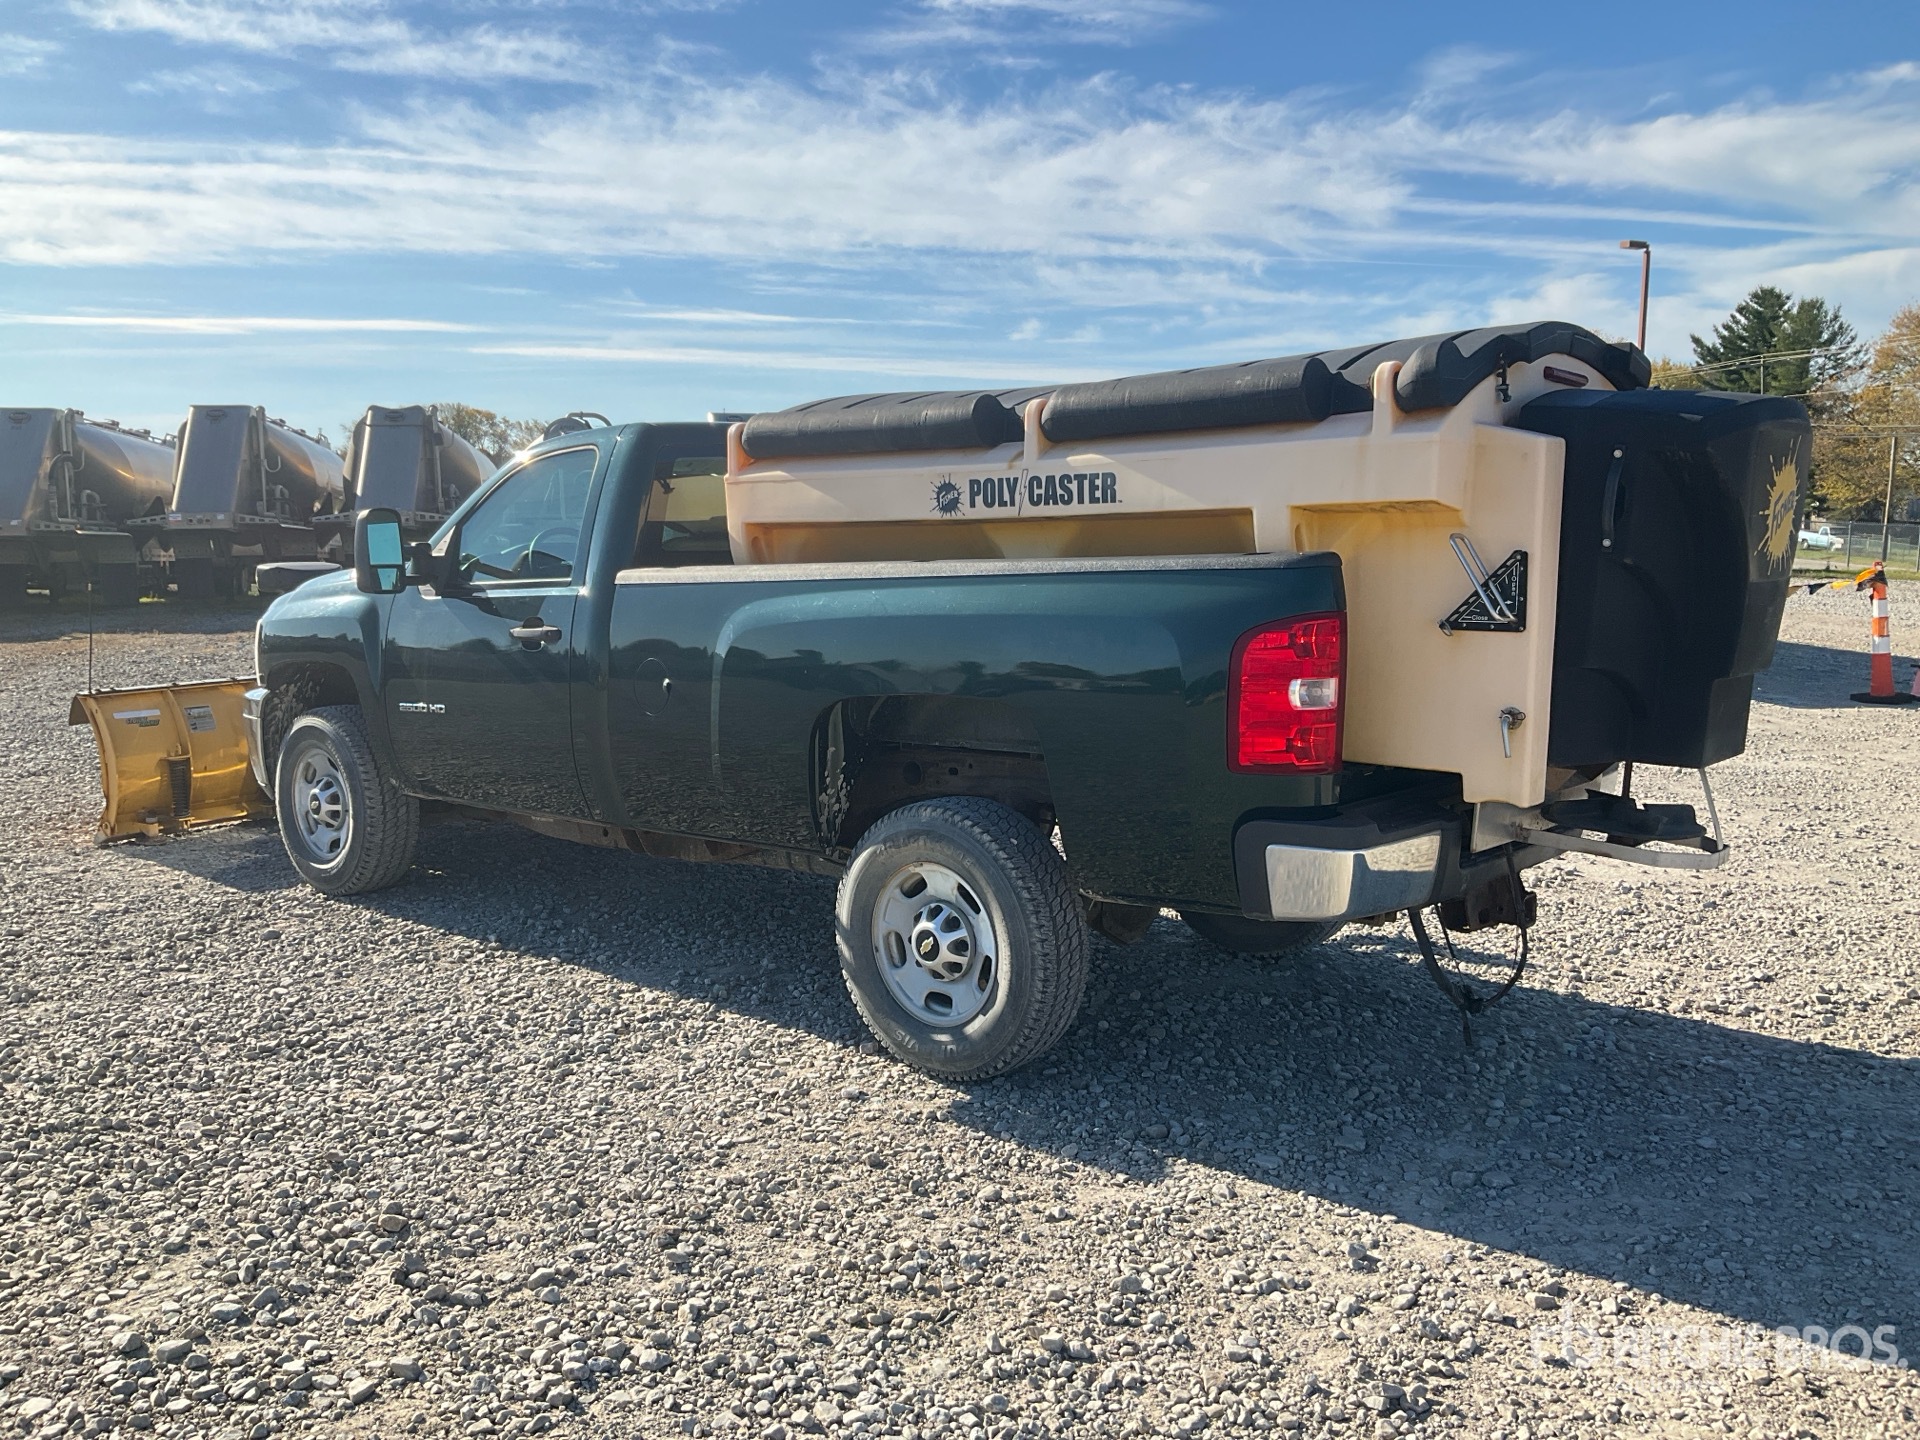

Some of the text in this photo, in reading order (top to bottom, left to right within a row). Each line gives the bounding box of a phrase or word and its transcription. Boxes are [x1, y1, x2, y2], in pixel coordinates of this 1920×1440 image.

[969, 472, 1117, 508] POLY CASTER
[399, 702, 446, 713] 2500 HD
